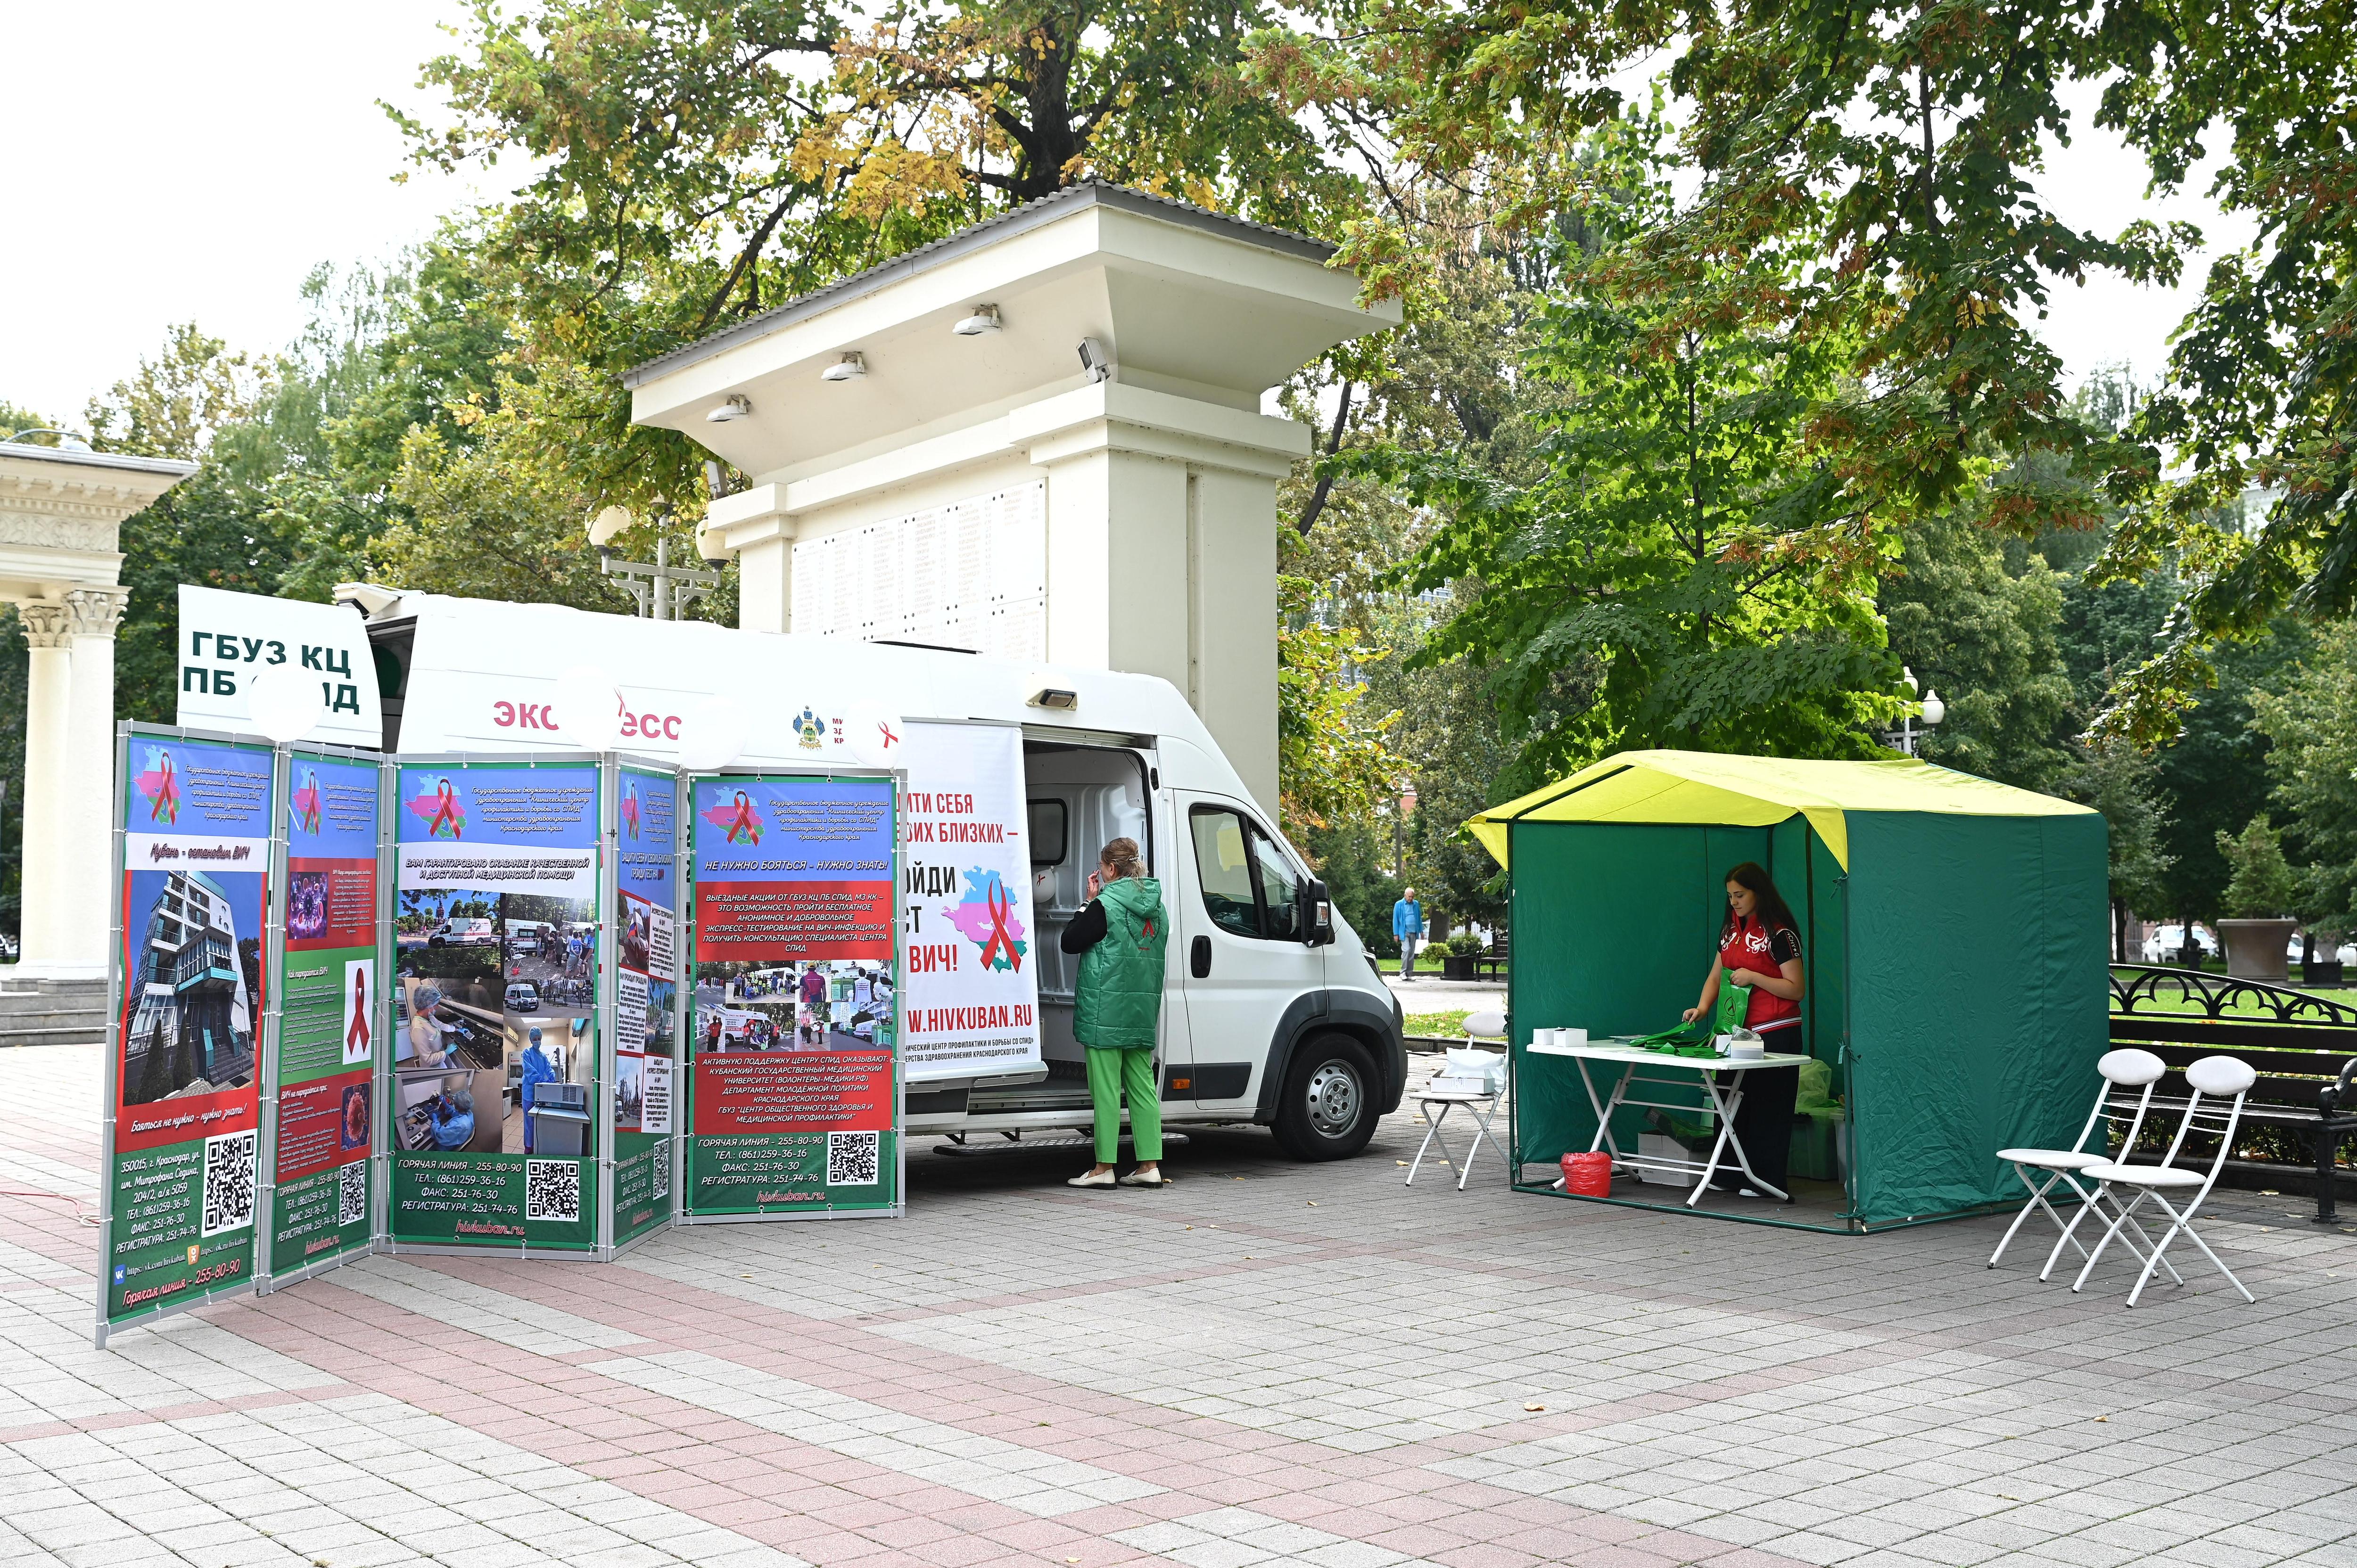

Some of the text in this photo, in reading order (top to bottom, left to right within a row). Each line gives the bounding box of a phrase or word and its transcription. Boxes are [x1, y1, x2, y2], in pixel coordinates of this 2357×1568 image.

[193, 632, 351, 679] ГБУЗ КЦ
[183, 666, 236, 696] ПБ
[471, 787, 593, 796] Государственное бюджетное учреждение
[475, 796, 527, 805] здравоохранения
[937, 793, 973, 813] СЕБЯ
[481, 805, 524, 813] профилактики
[561, 805, 583, 813] СПИД"
[500, 825, 546, 833] Краснодарского
[939, 822, 1003, 843] БЛИЗКИХ
[150, 843, 250, 861] Кубань остановим ВИЧ
[405, 858, 590, 868] ВАМ ГАРАНТИРОВАНО ОКАЗАНИЕ КАЧЕСТВЕННОЙ
[705, 860, 889, 870] НЕ НУЖНО БОЯТЬСЯ НУЖНО ЗНАТЬ!
[420, 869, 575, 881] И ДОСТУПНОЙ МЕДИЦИНСКОЙ ПОМОЩИ
[793, 903, 824, 911] ПРОЙТИ
[793, 914, 854, 922] ДОБРОВОЛЬНОЕ
[909, 944, 957, 973] ВИЧ!
[931, 1043, 947, 1051] ЦЕНТР
[948, 1040, 987, 1049] ПРОФИЛАКТИКИ
[925, 1051, 972, 1061] ЗДРАВООХРАНЕНИЯ
[973, 1048, 1015, 1058] КРАСНОДАРСКОГО
[709, 1064, 882, 1075] КУБАНСКИЙ ГОСУДАРСТВЕННЫЙ МЕДИЦИНСКИЙ
[775, 1075, 868, 1083] (ВОЛОНТЁРЫ-МЕДИКИ.РФ)
[722, 1086, 775, 1095] ДЕПАРТАМЕНТ
[776, 1084, 829, 1093] МОЛОДЁЖНОЙ
[753, 1095, 819, 1103] КРАСНОДАРСКОГО
[765, 1105, 826, 1113] ОБЩЕСТВЕННОГО
[131, 1103, 247, 1132] Бояться не нужно нужно знать!
[736, 1114, 793, 1123] МЕДИЦИНСКОЙ
[698, 1136, 823, 1147] ГОРЯЧАЯ ЛИНИЯ 255-80-90
[716, 1149, 807, 1159] ТЕЛ.: (861)259-36-16
[121, 1158, 147, 1173] 350015,
[156, 1153, 190, 1168] Краснодар,
[398, 1160, 521, 1172] ГОРЯЧАЯ ЛИНИЯ 255-80-90
[722, 1162, 799, 1172] ФАКС: 251-76-30
[121, 1167, 198, 1189] им. Митрофана Седина,
[415, 1174, 505, 1185] ТЕЛ.: (861)259-36-16
[701, 1174, 818, 1185] РЕГИСТРАТУРА: 251-74-76
[133, 1189, 156, 1203] 204/2,
[171, 1182, 188, 1195] 5059
[421, 1187, 498, 1199] ФАКС: 251-76-30
[756, 1190, 825, 1202] hivkuban.ru
[127, 1197, 190, 1220] ТЕЛ.: (861)259-36-16
[402, 1201, 517, 1214] РЕГИСТРАТУРА: 251-74-76
[131, 1213, 185, 1234] ФАКС: 251-76-30
[455, 1219, 525, 1235] hivkuban.ru
[116, 1224, 197, 1253] РЕГИСТРАТУРА: 251-74-76
[127, 1254, 185, 1276] https://vk.com/hivkuban
[123, 1259, 240, 1308] Горячая линия 255-80-90
